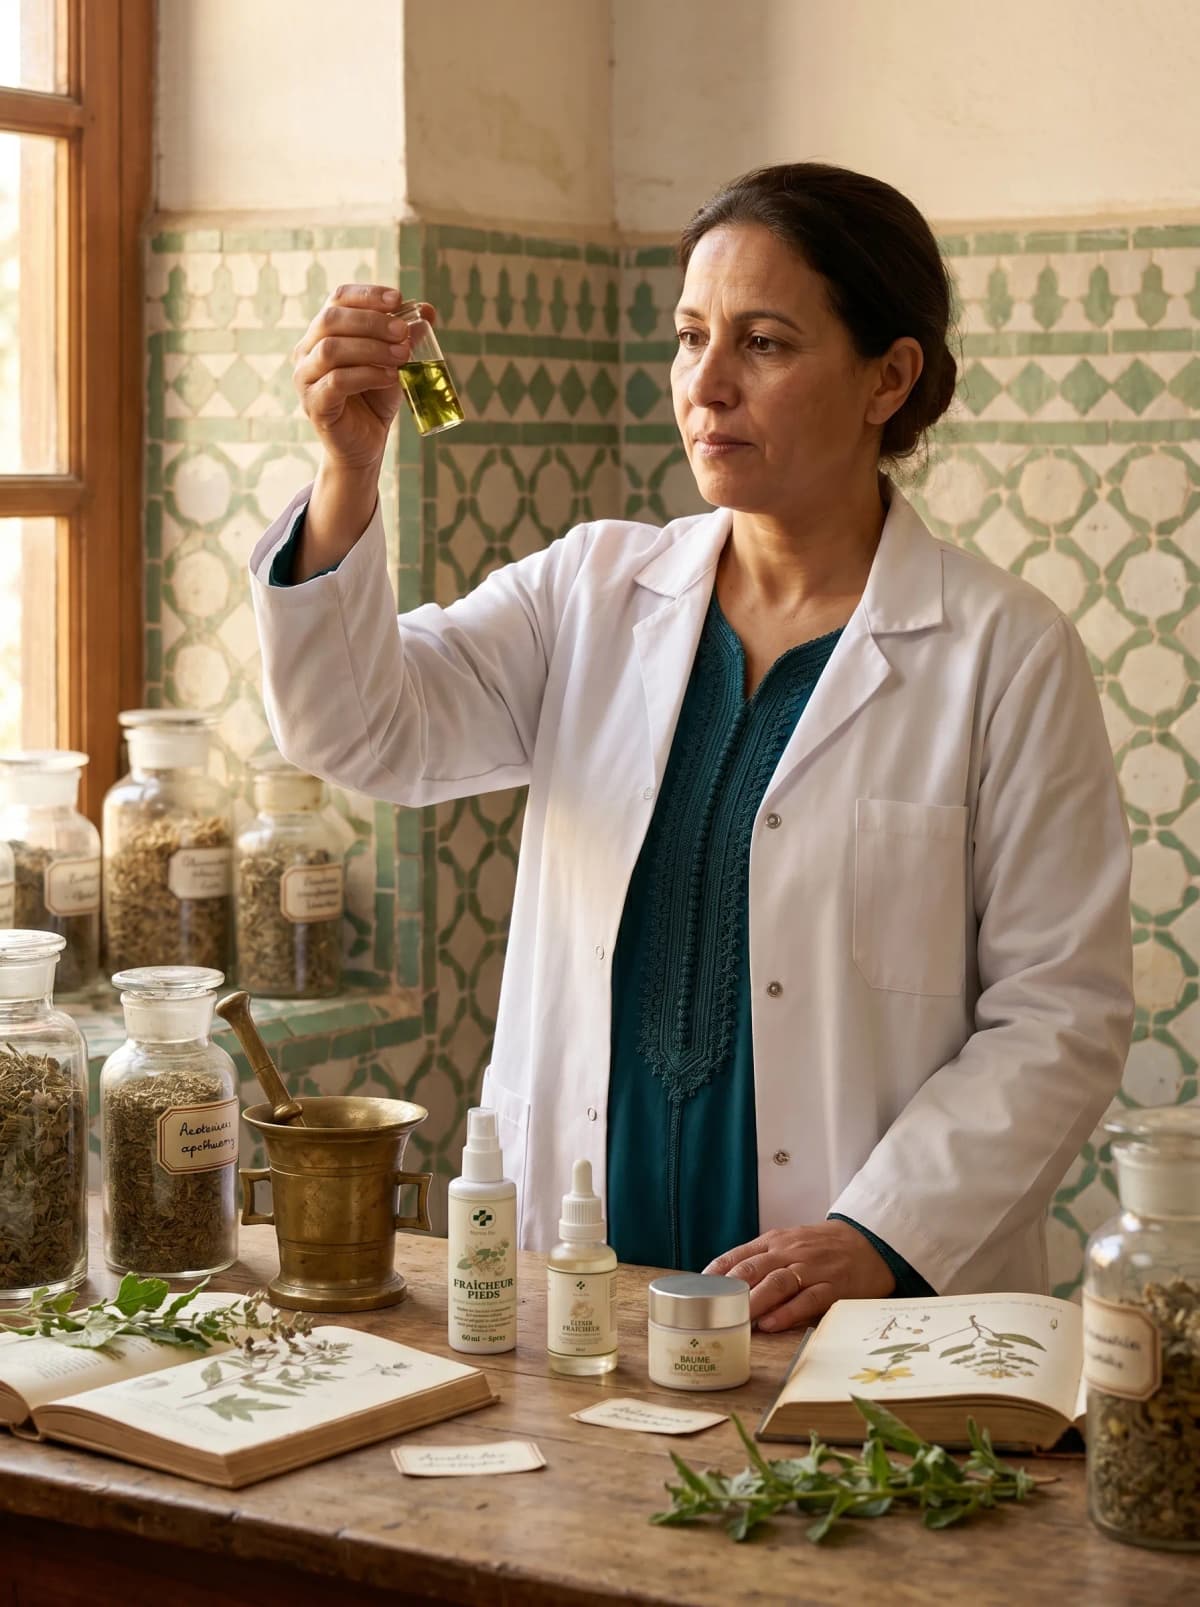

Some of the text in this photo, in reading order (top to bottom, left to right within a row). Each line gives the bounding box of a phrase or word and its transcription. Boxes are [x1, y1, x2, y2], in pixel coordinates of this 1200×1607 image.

[467, 1290, 500, 1299] PIEDS
[680, 1355, 711, 1364] BAUME
[674, 1363, 716, 1372] DOUCEUR
